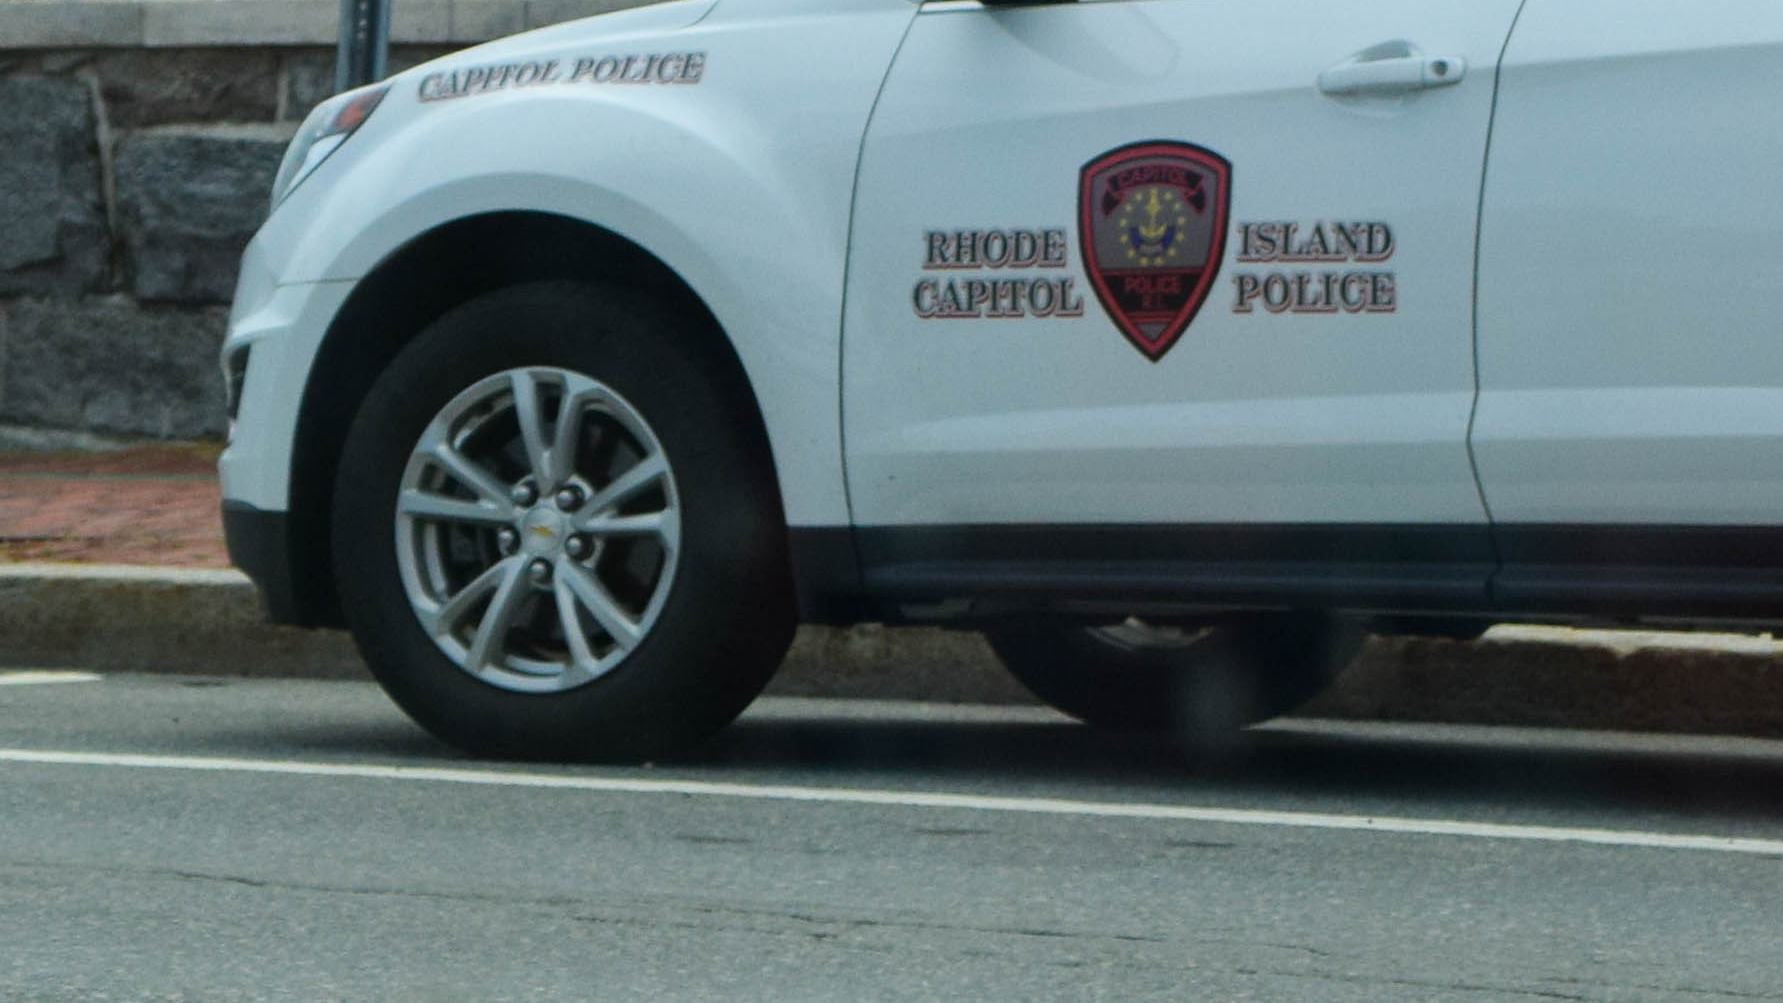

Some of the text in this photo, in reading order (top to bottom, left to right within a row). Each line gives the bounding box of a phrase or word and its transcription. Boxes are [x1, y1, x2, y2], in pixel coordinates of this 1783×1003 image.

[417, 51, 708, 104] CAPITOL POLICE
[922, 221, 1394, 269] RHODE ISLAND
[912, 273, 1397, 319] CAPITOL POLICE
